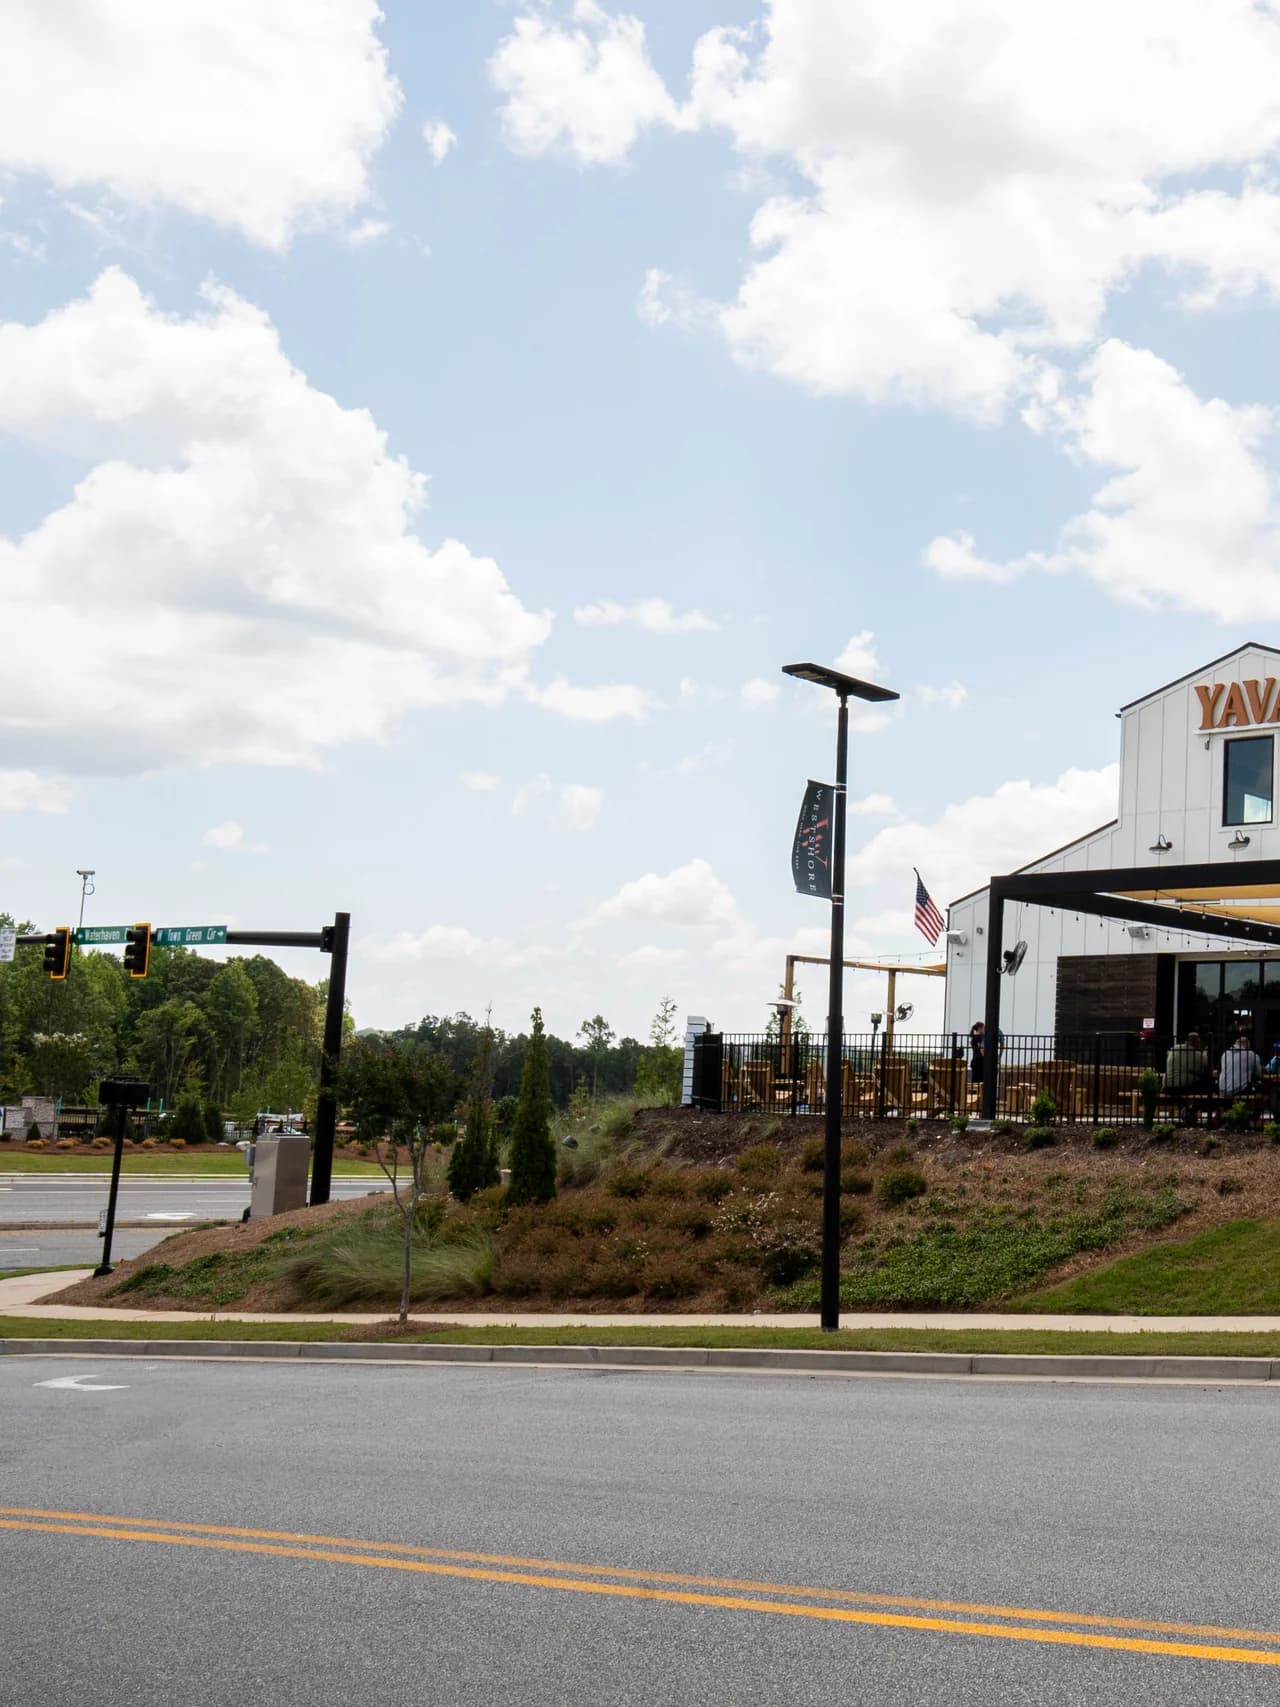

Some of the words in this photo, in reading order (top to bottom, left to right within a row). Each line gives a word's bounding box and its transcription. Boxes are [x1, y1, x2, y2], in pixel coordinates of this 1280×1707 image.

[808, 789, 824, 892] WESTSHORE
[84, 928, 121, 942] Waterhaven
[168, 929, 182, 942] Town
[185, 928, 203, 942] Green
[206, 927, 217, 941] Cir
